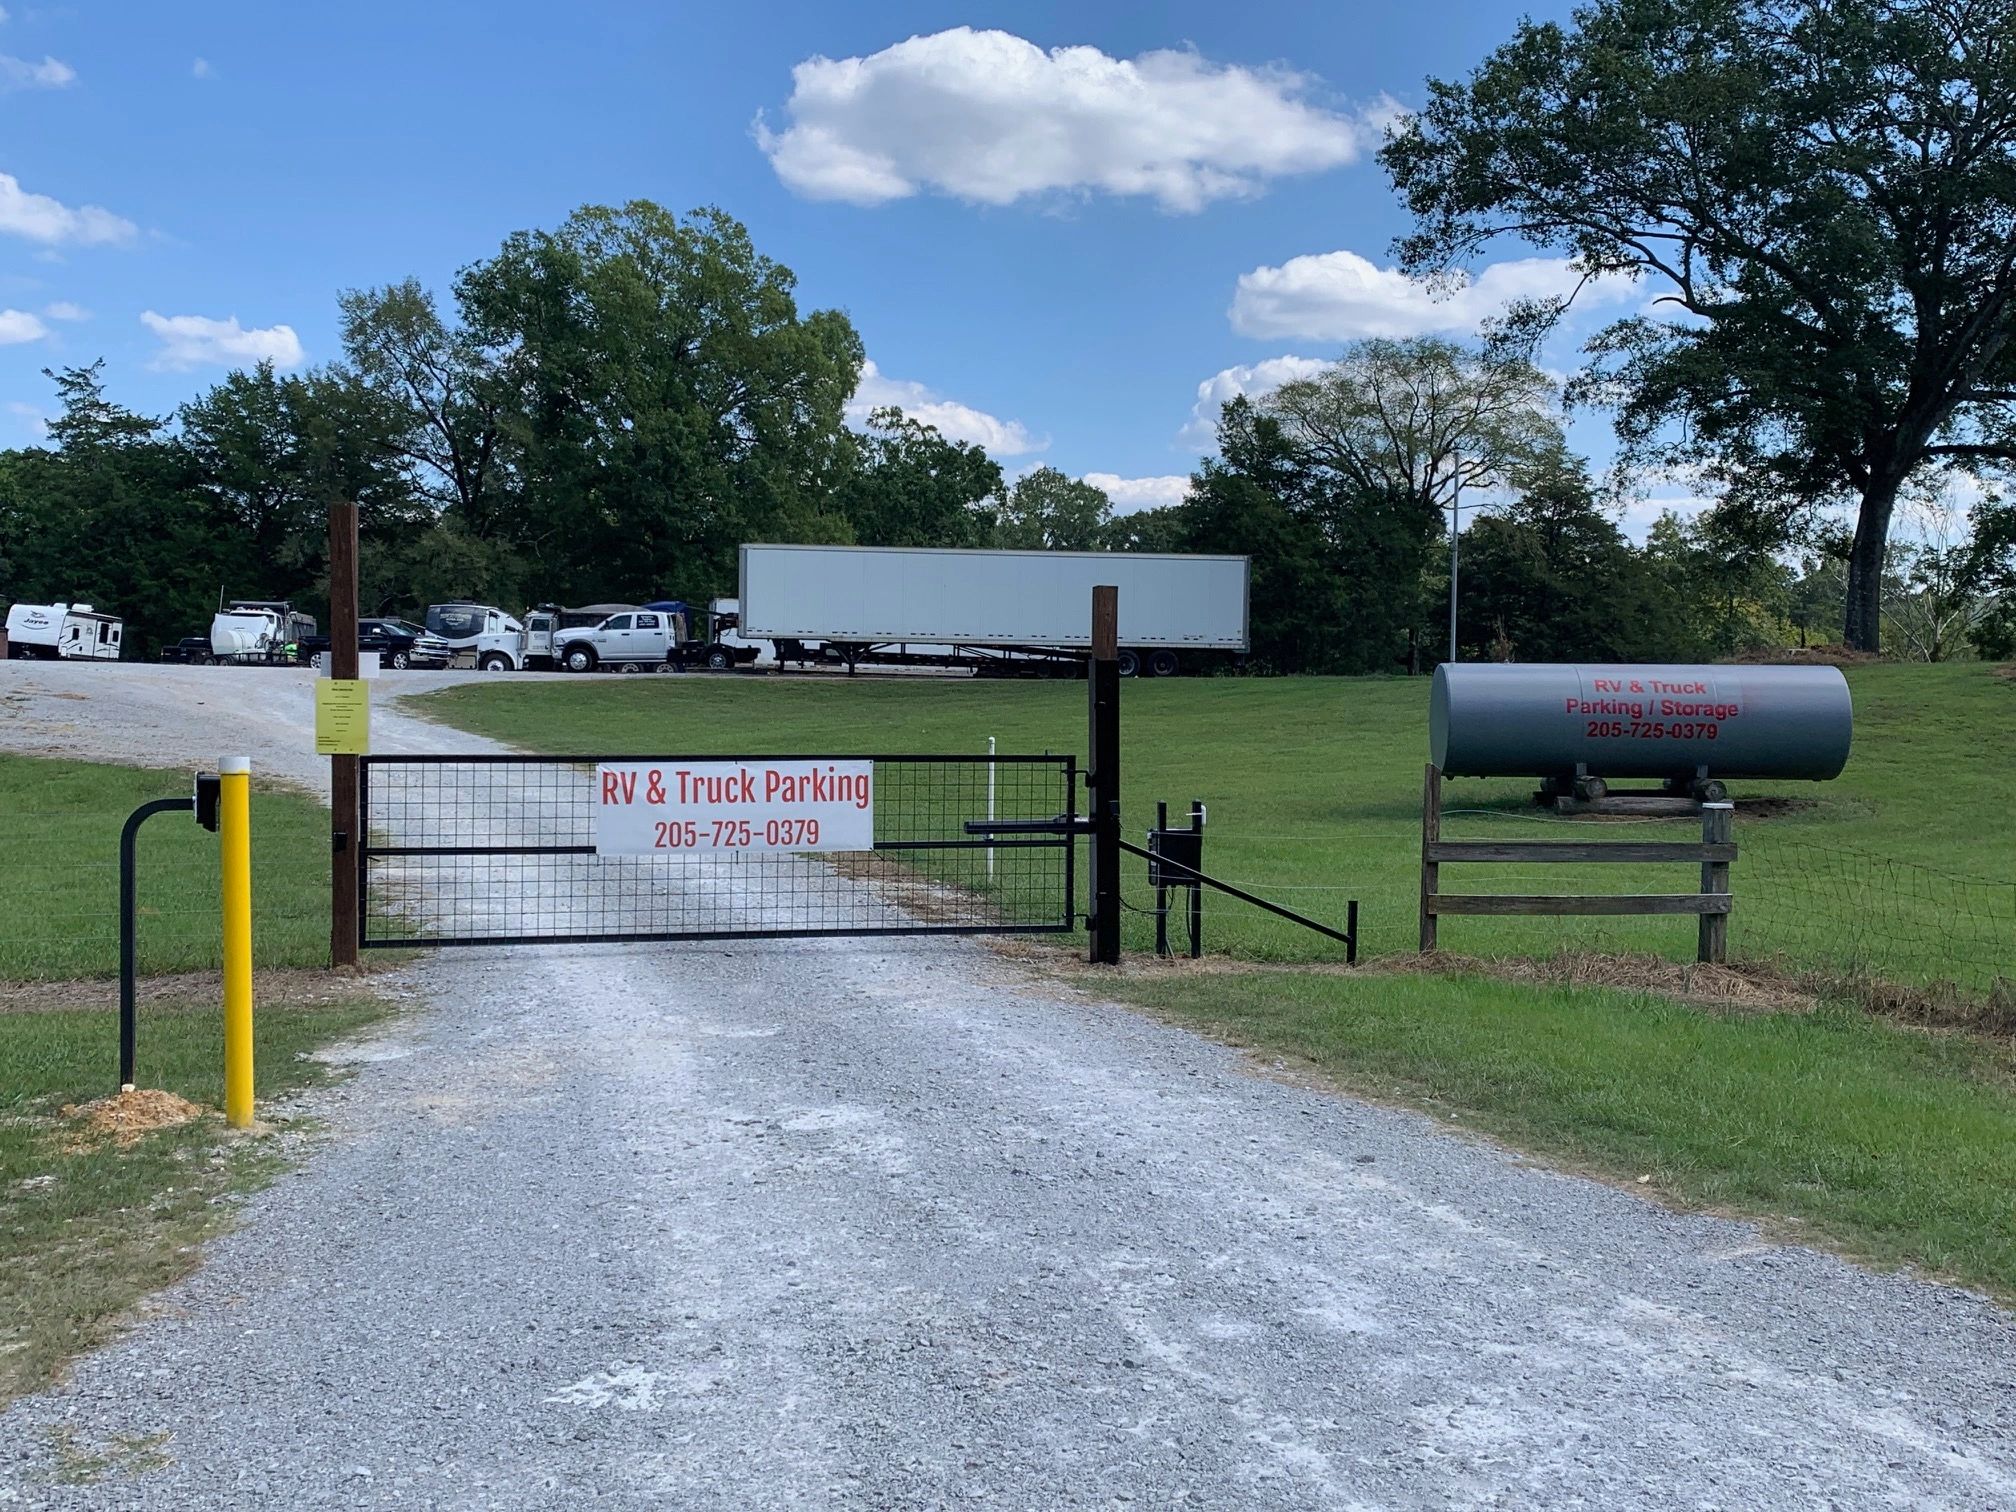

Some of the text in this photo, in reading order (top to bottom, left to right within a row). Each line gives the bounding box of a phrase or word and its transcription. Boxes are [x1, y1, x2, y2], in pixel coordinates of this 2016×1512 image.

[1594, 679, 1706, 694] RV & Truck
[1566, 699, 1739, 720] Parking / Storage
[1587, 721, 1718, 739] 205-725-0379
[602, 767, 869, 809] RV & Truck Parking
[654, 818, 819, 848] 205-725-0379
